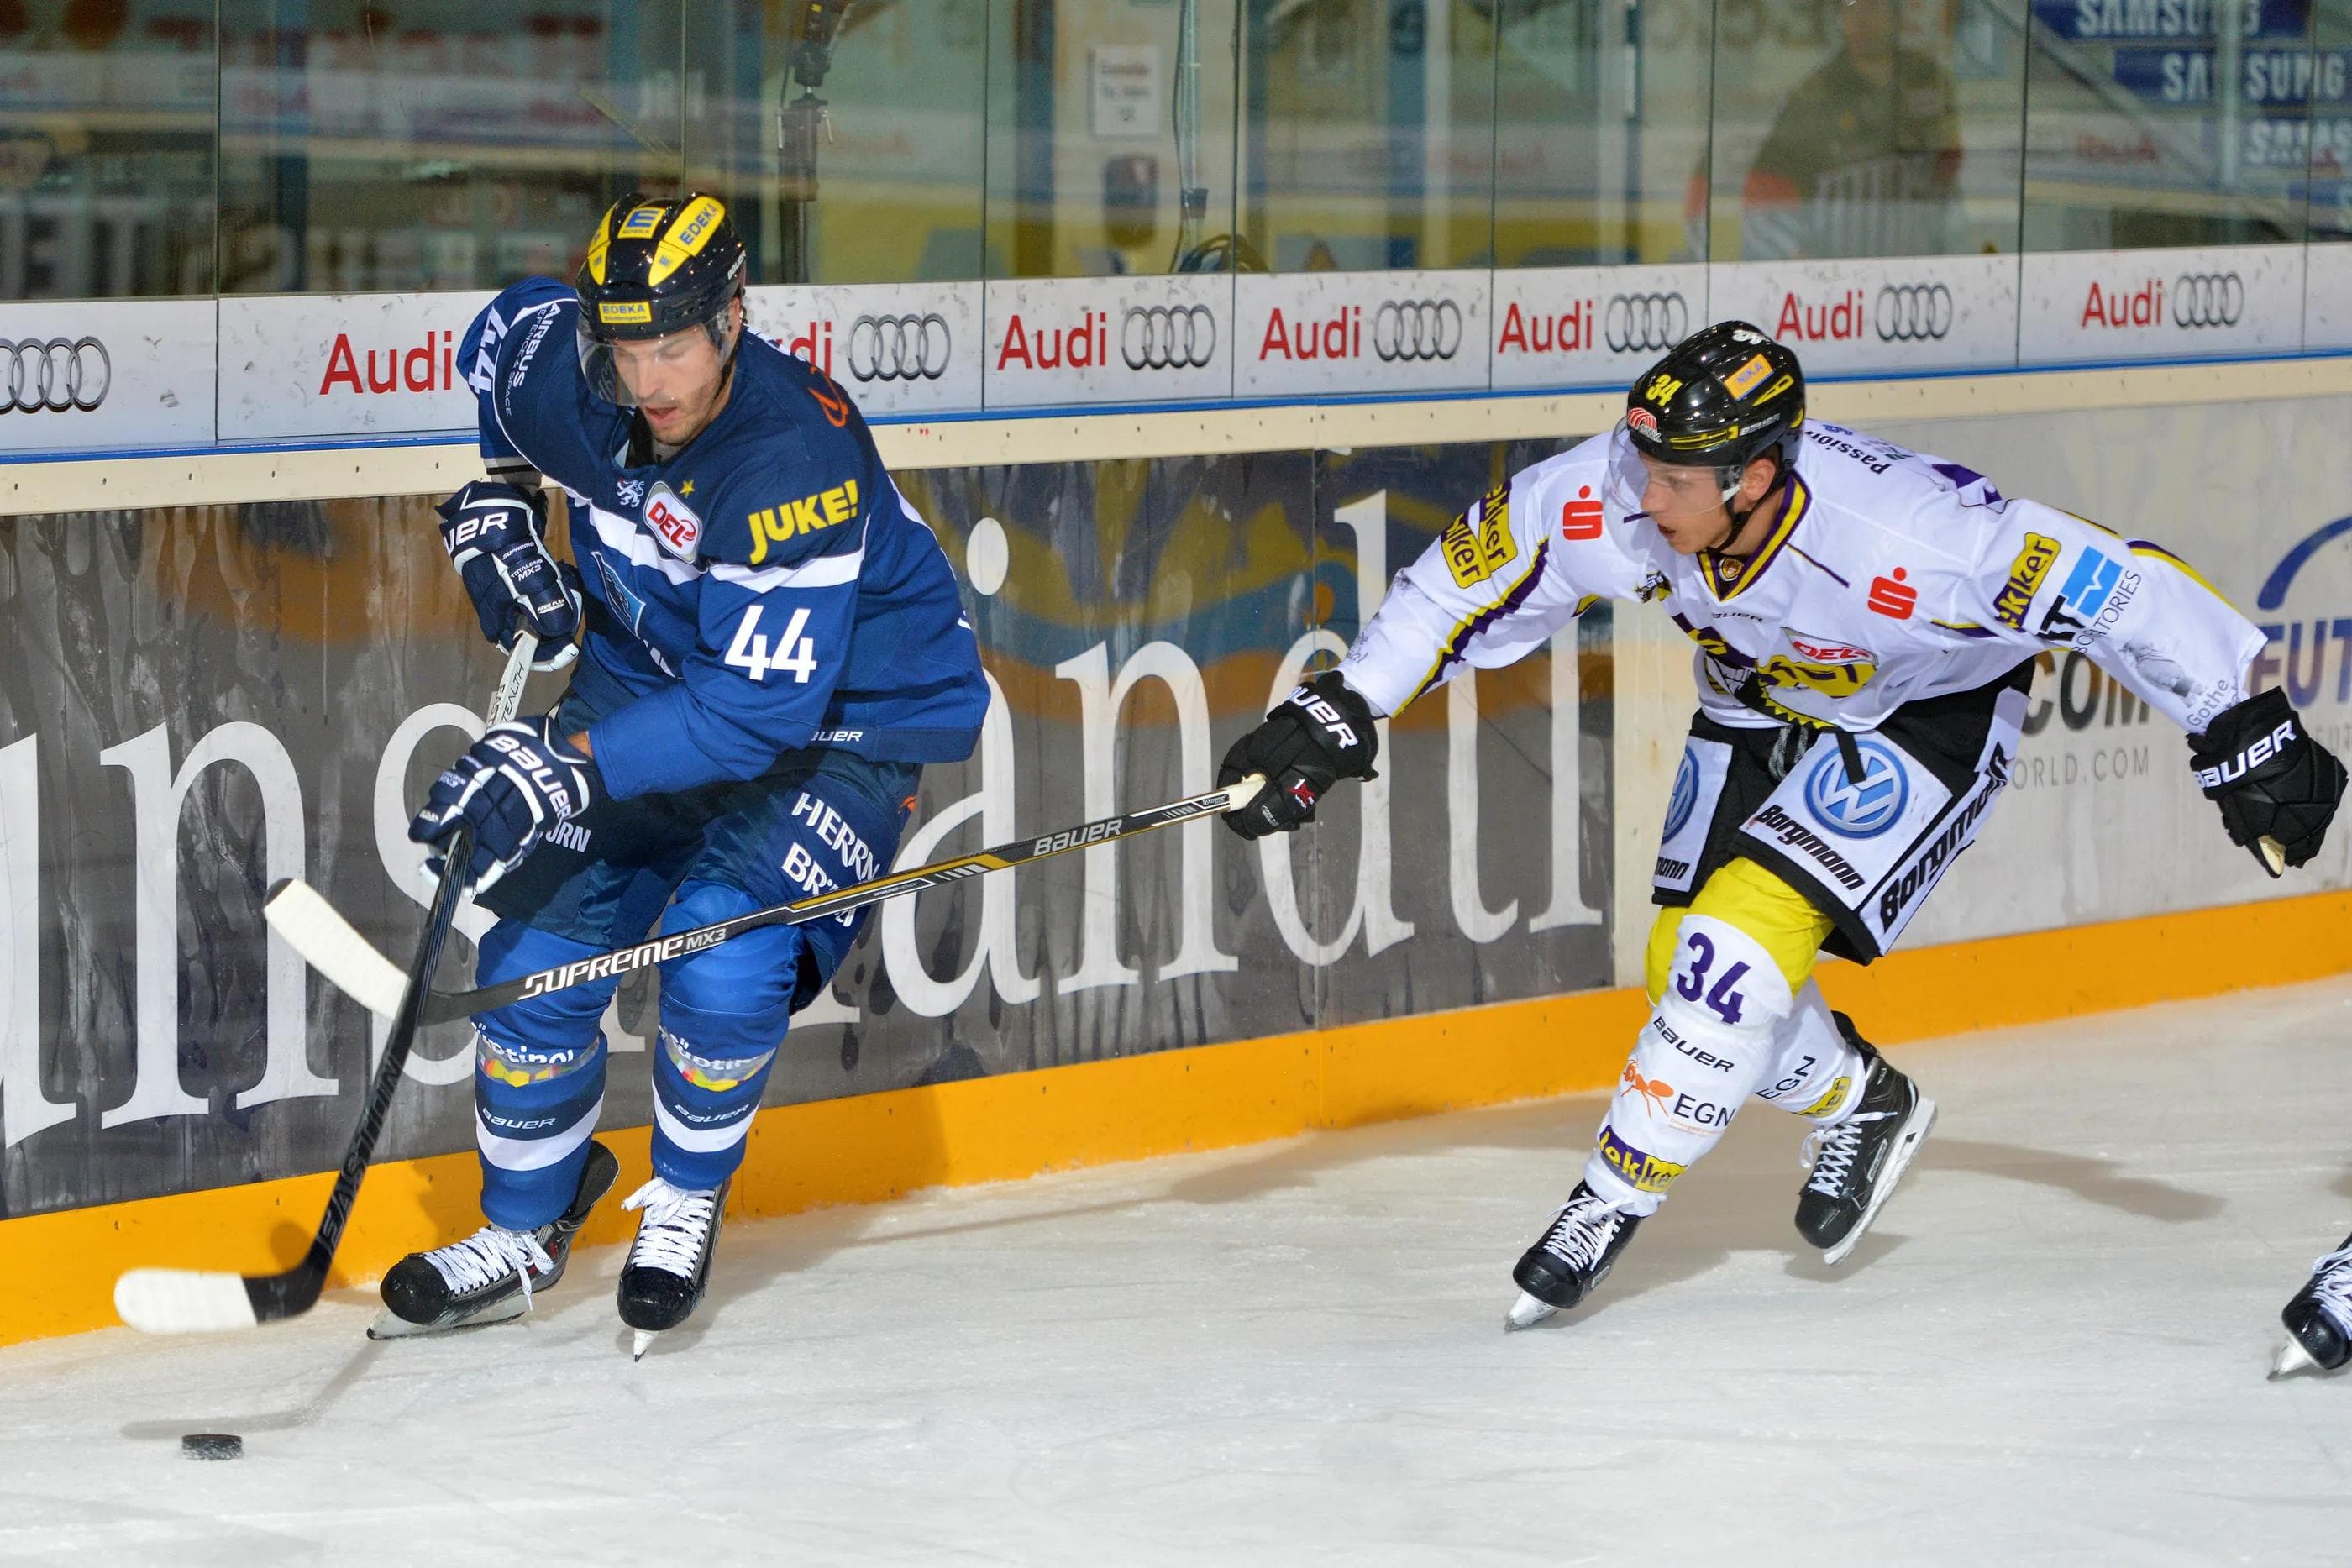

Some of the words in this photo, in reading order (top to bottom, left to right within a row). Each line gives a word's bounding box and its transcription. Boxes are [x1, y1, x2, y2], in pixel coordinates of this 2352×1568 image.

[2077, 0, 2261, 36] SAMSUG
[2162, 52, 2345, 102] SASUNG
[627, 210, 667, 228] E
[680, 202, 718, 245] EDEKA
[602, 304, 645, 314] EDEKA
[1499, 301, 1592, 354] Audi
[1775, 289, 1864, 341] Audi
[2082, 278, 2162, 329] Audi
[469, 304, 509, 394] 44
[512, 302, 561, 387] AIRBUS
[997, 312, 1106, 370] Audi
[1260, 306, 1360, 360] Audi
[319, 331, 452, 395] Audi
[505, 371, 516, 416] SPACE
[1646, 374, 1683, 406] 34
[647, 501, 698, 548] DEL
[748, 479, 859, 564] JUKE!
[517, 564, 543, 582] MX3
[725, 605, 817, 684] 44
[1793, 641, 1870, 661] DEL
[1285, 685, 1359, 750] UER
[2187, 679, 2229, 726] Gothe
[484, 735, 572, 823] BAUER
[2192, 719, 2297, 790] BAUER
[791, 792, 881, 881] HERRN
[1033, 819, 1122, 857] BAUER
[1755, 805, 1866, 892] Borgmann
[517, 935, 684, 1000] SUPREME
[685, 928, 727, 951] MX3
[1677, 932, 1751, 1025] 34
[1653, 1016, 1735, 1072] BAUER
[1754, 1055, 1817, 1099] EGN
[482, 1107, 556, 1130] BAUER
[674, 1103, 750, 1123] BAUER
[1673, 1093, 1737, 1127] EGN
